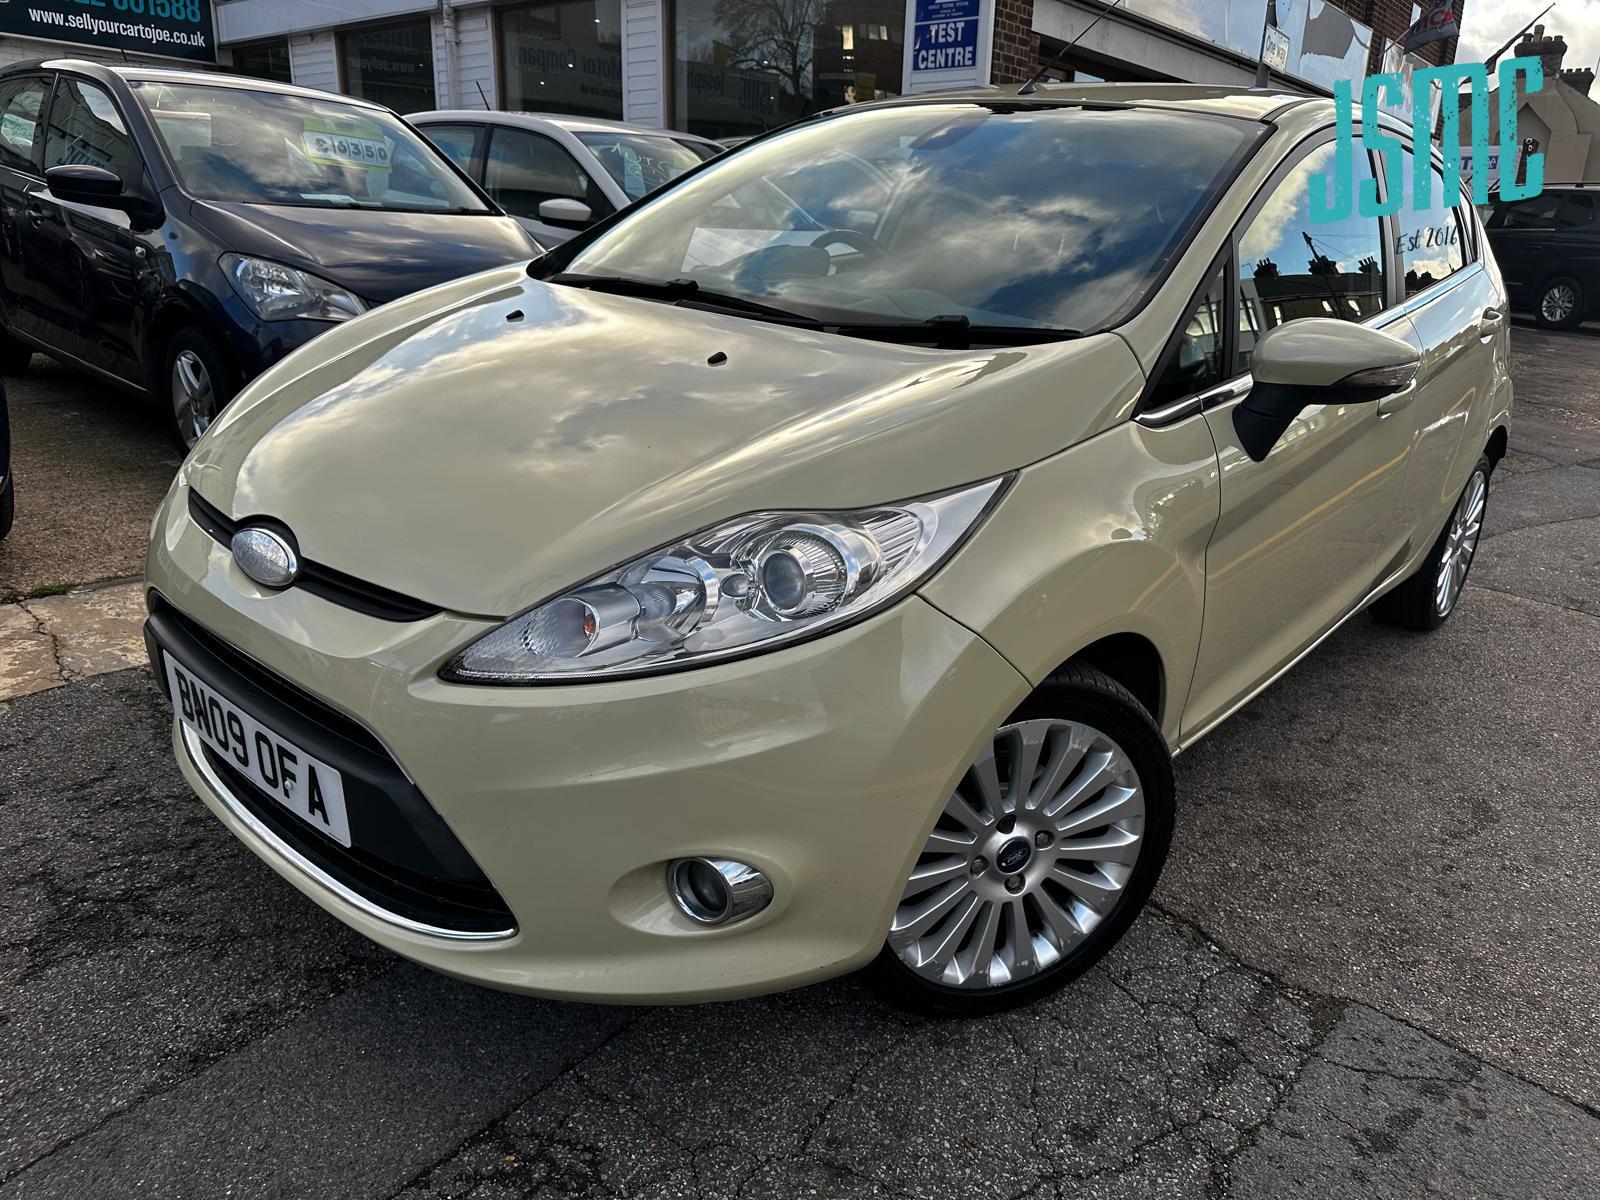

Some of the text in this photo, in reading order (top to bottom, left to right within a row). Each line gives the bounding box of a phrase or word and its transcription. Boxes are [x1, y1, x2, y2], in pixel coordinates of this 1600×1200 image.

[28, 8, 206, 47] www.sellyourcartojoe.co.uk
[929, 21, 965, 44] TEST
[918, 46, 973, 69] CENTRE
[174, 666, 250, 768] BN09
